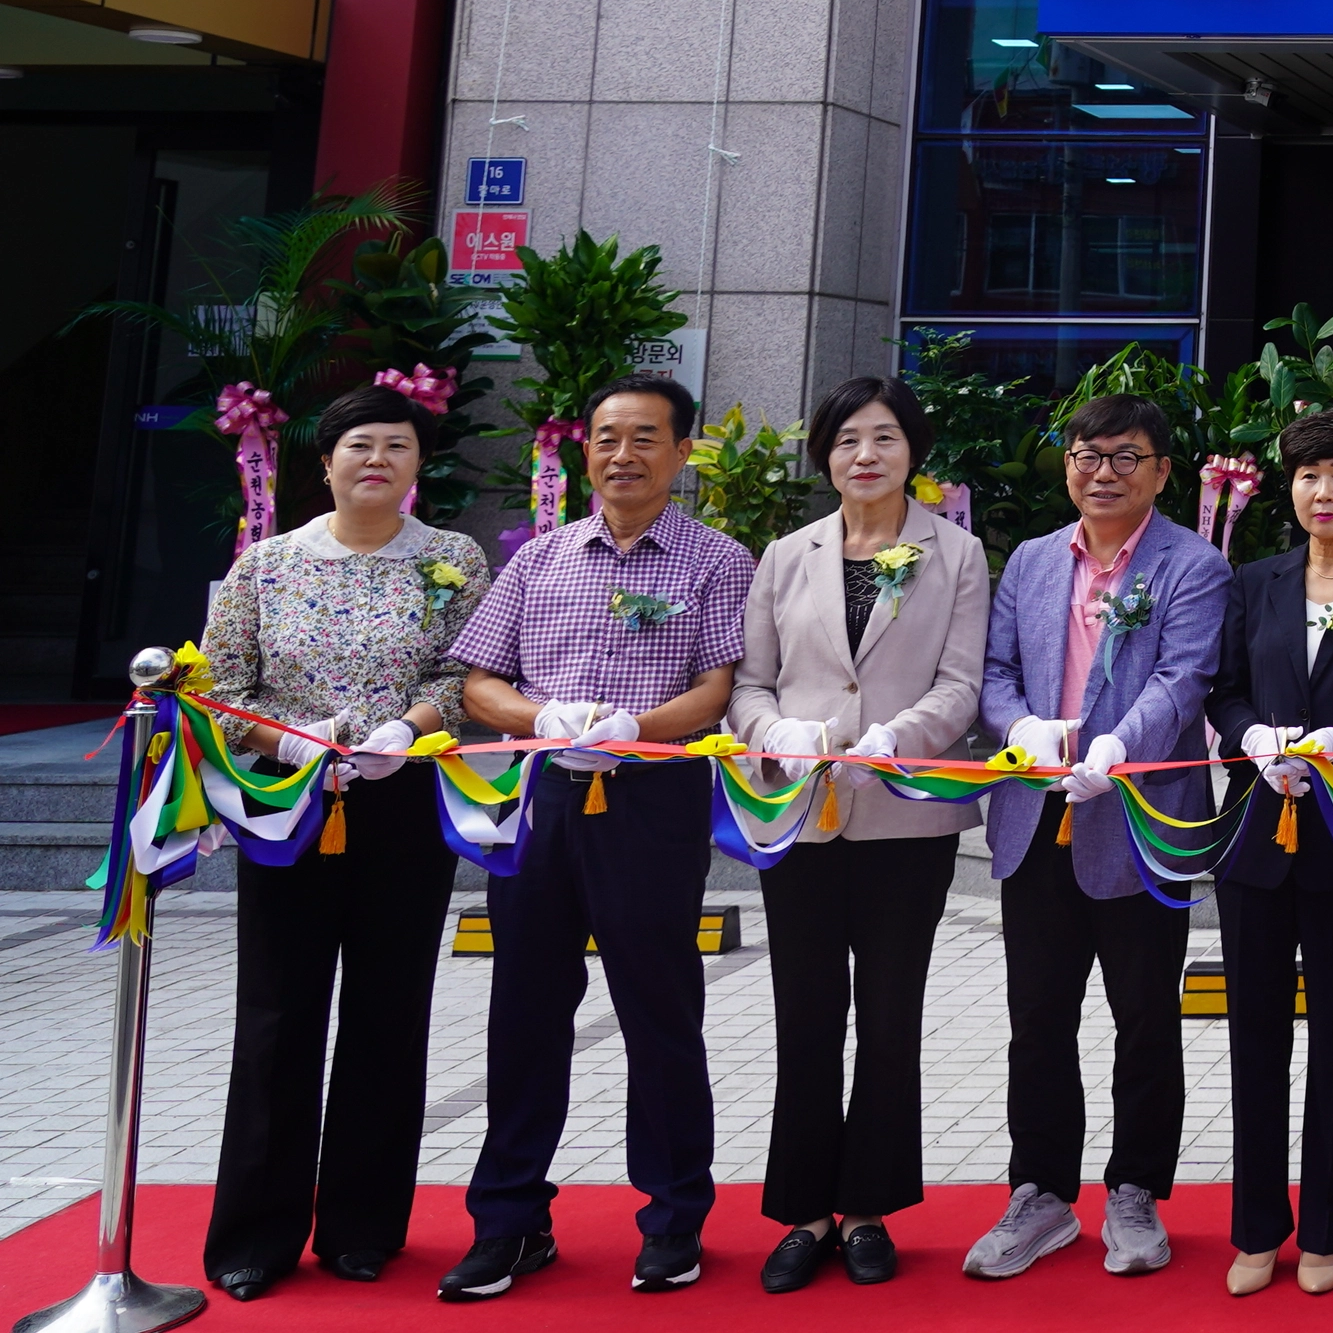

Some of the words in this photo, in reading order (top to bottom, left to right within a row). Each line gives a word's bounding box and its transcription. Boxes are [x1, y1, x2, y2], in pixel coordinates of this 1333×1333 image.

[489, 166, 504, 179] 16
[449, 273, 492, 285] SECOM
[624, 343, 684, 365] 방문외
[135, 412, 159, 423] NH
